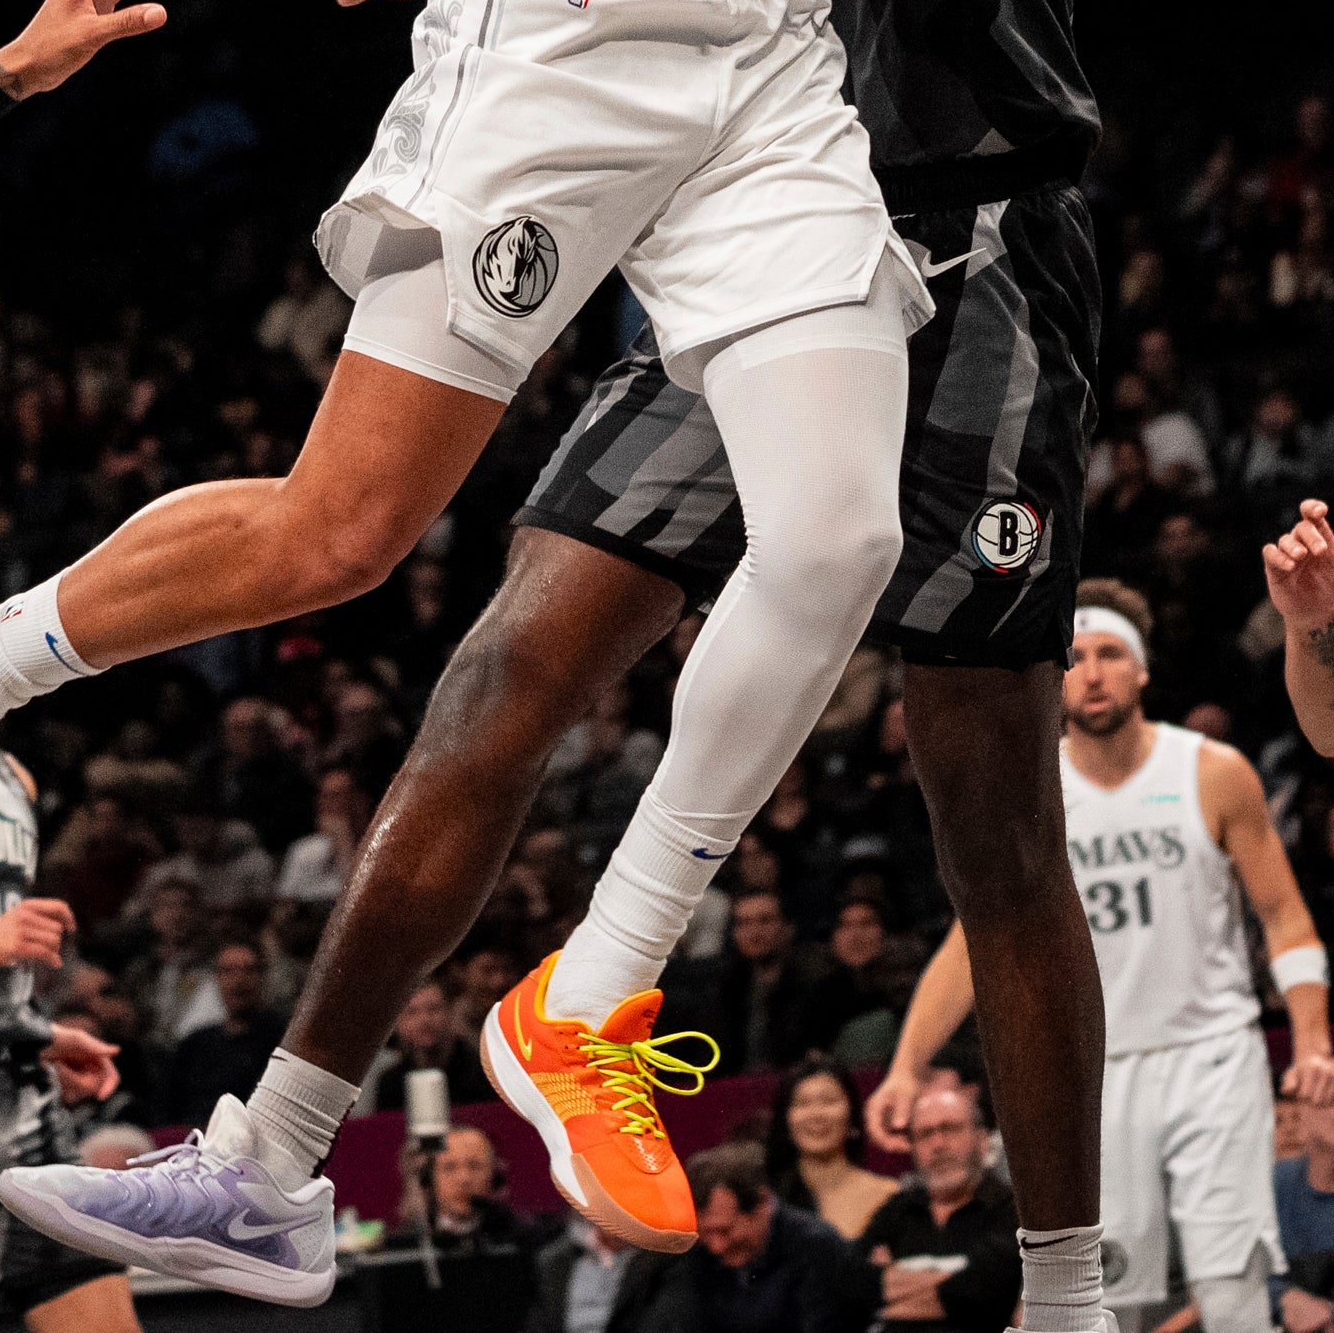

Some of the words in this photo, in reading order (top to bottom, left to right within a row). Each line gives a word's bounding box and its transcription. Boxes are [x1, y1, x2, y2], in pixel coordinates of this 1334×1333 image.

[999, 511, 1019, 557] B
[1067, 825, 1187, 871] MAVS
[1086, 876, 1154, 934] 31
